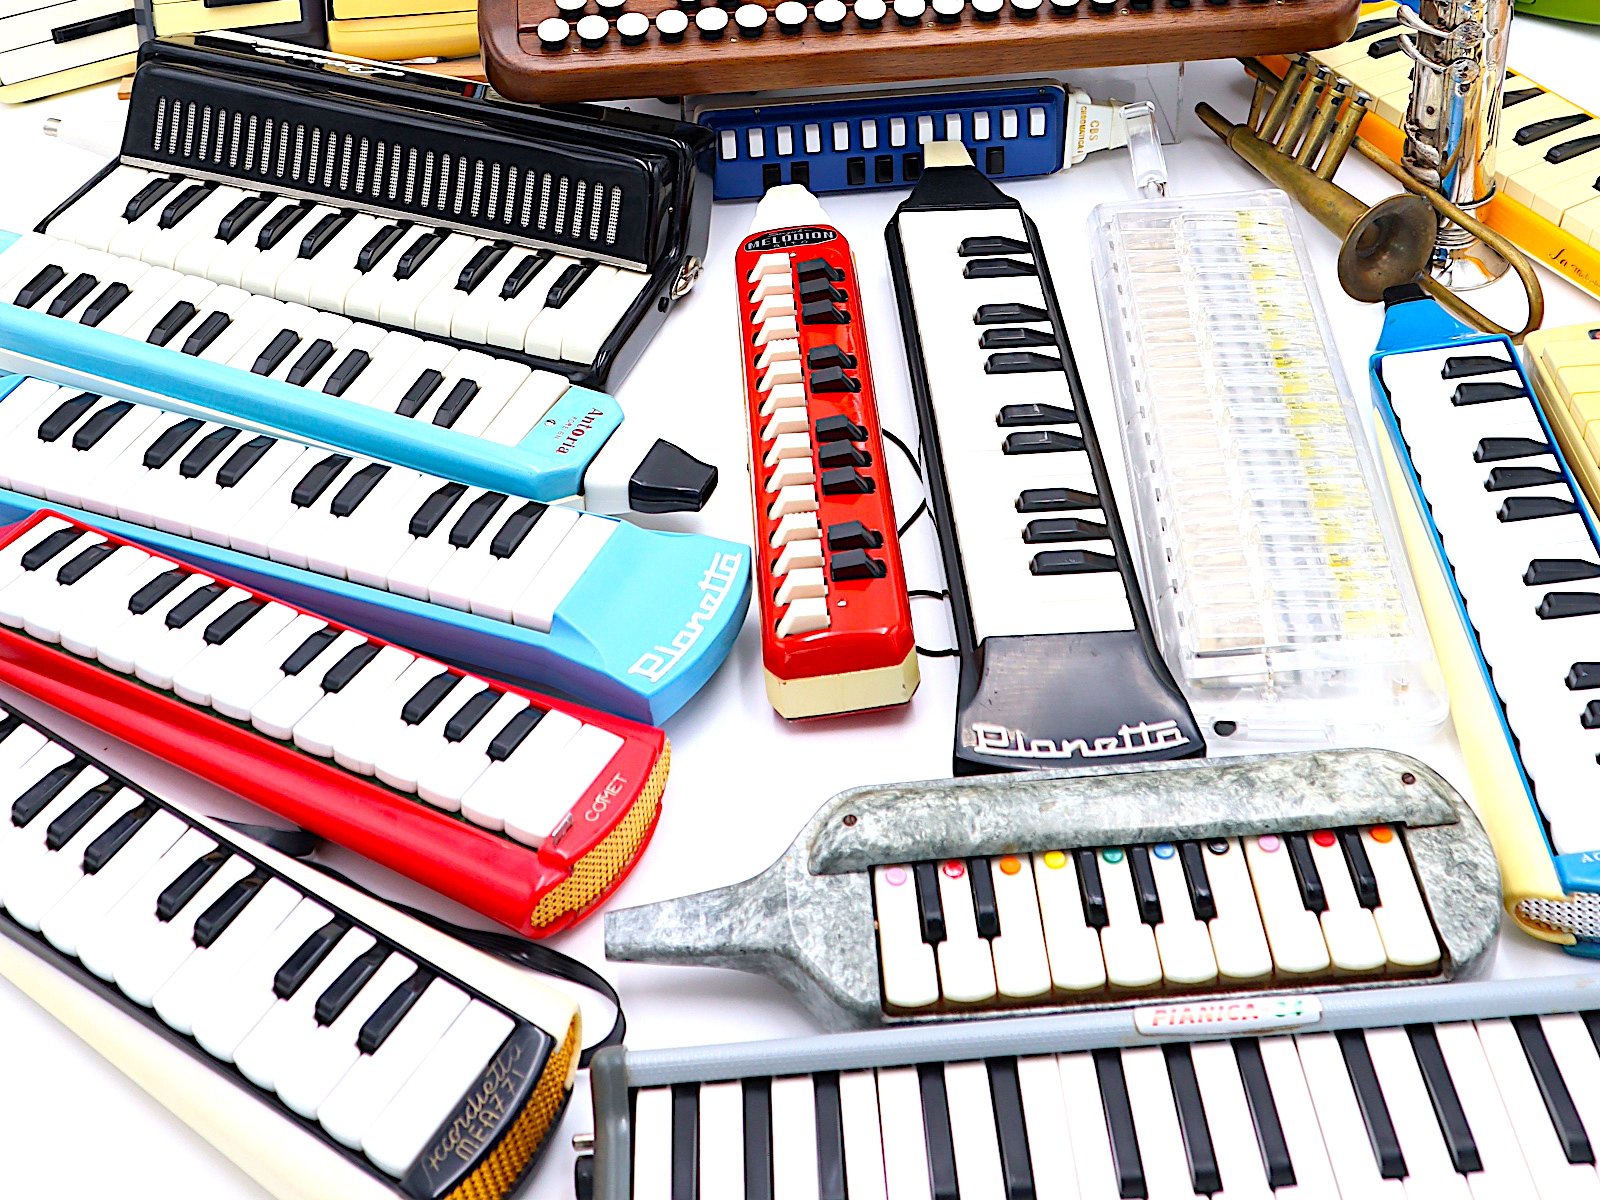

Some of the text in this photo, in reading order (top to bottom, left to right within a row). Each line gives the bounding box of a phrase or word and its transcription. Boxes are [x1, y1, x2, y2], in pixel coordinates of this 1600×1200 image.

[1089, 120, 1100, 141] CBS
[747, 231, 834, 250] MELODION
[555, 407, 604, 454] Antoria
[584, 772, 628, 822] COMET
[1151, 1003, 1259, 1027] PIANICA
